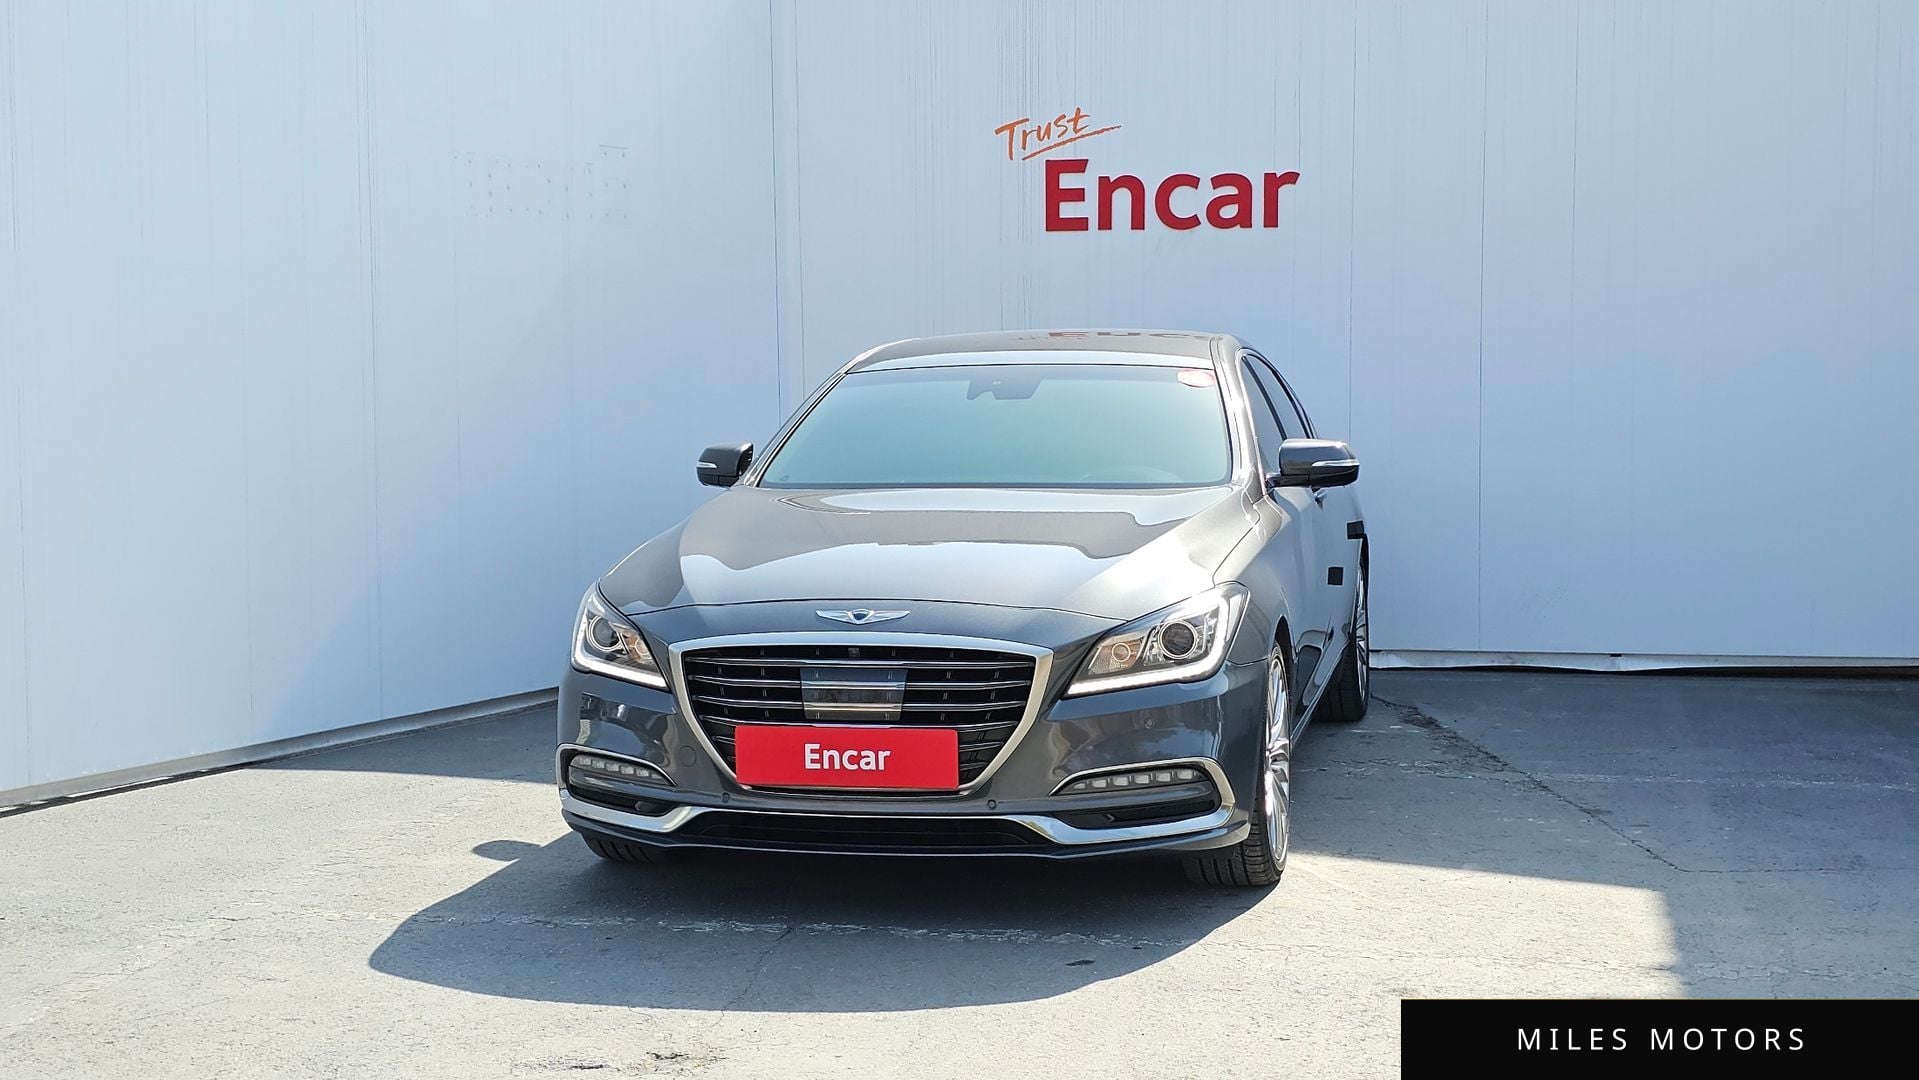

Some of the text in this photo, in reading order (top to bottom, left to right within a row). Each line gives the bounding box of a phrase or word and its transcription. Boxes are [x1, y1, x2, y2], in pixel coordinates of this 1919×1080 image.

[994, 107, 1091, 161] Trust
[1044, 158, 1301, 232] Encar
[803, 743, 891, 771] Encar
